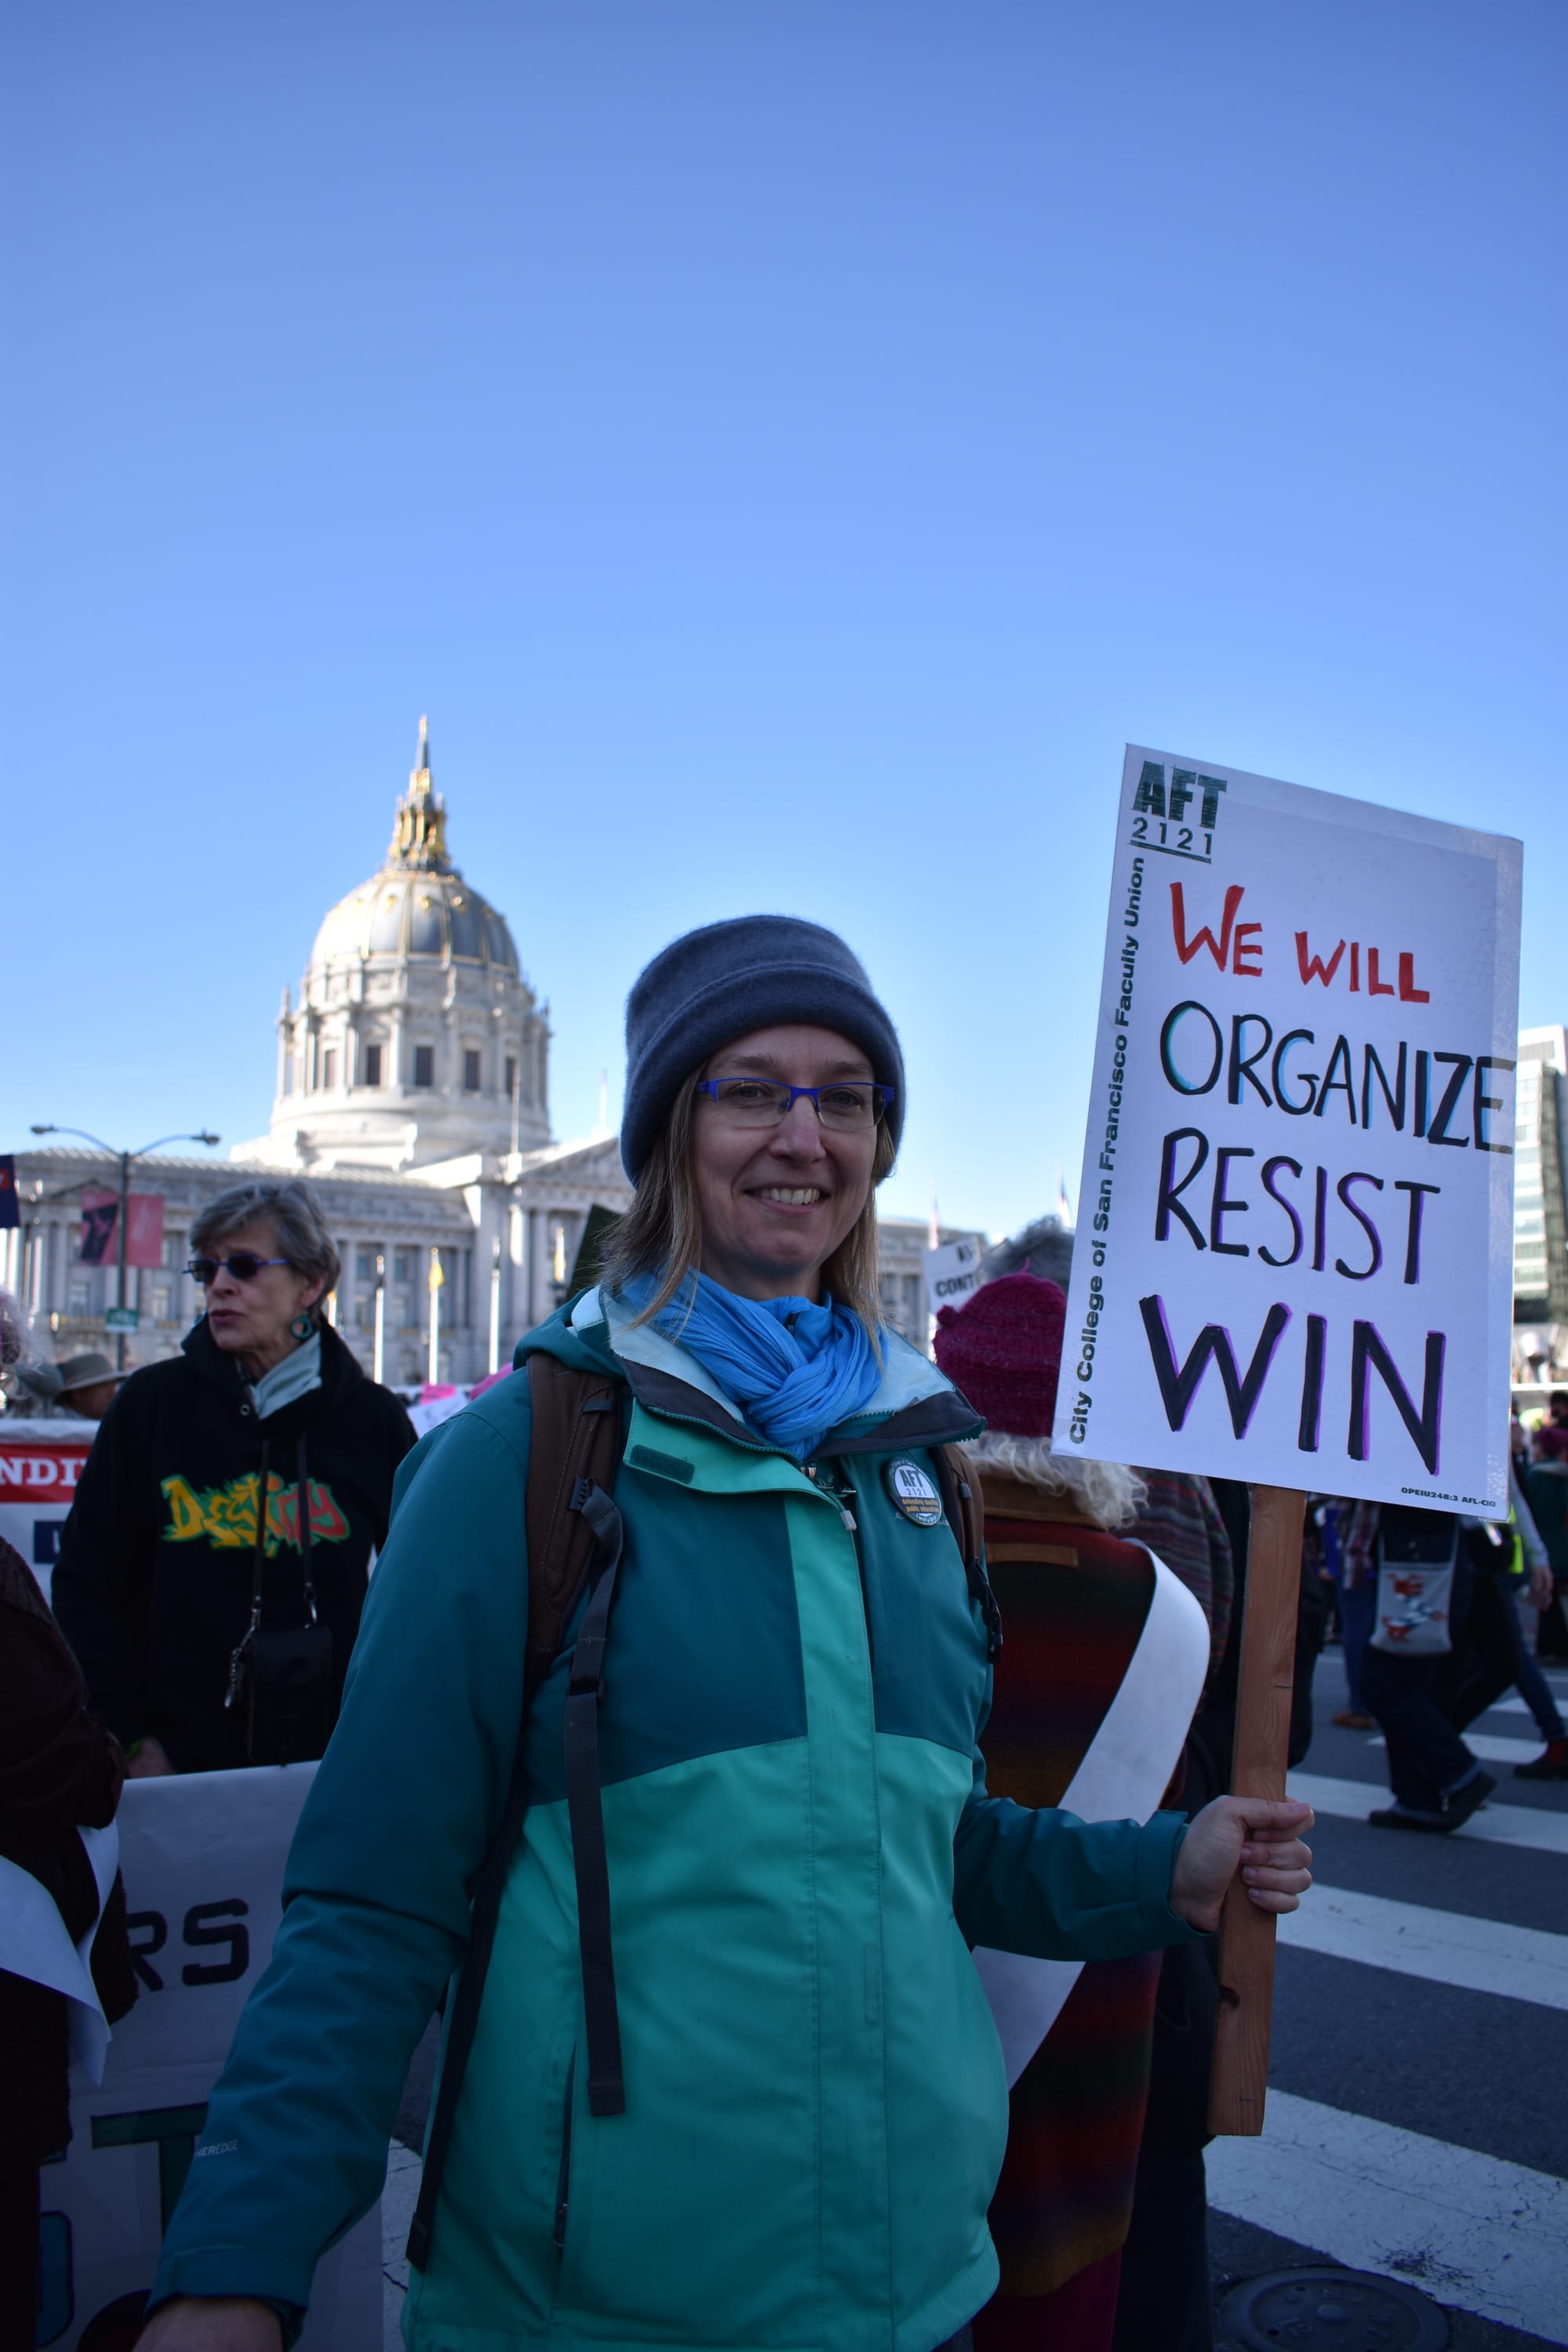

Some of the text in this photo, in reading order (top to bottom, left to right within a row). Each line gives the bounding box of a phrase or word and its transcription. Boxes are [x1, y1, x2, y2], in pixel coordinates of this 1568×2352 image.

[1131, 760, 1227, 829] AFT
[1132, 817, 1212, 855] 2121
[1170, 882, 1430, 1004] WE WILL
[1160, 1000, 1517, 1153] ORGANIZE
[1070, 857, 1145, 1444] City College of San Francisco Faculty Union
[1155, 1127, 1440, 1284] RESIST
[1138, 1294, 1446, 1476] WIN
[0, 1457, 88, 1486] NDI
[898, 1469, 924, 1487] AFT
